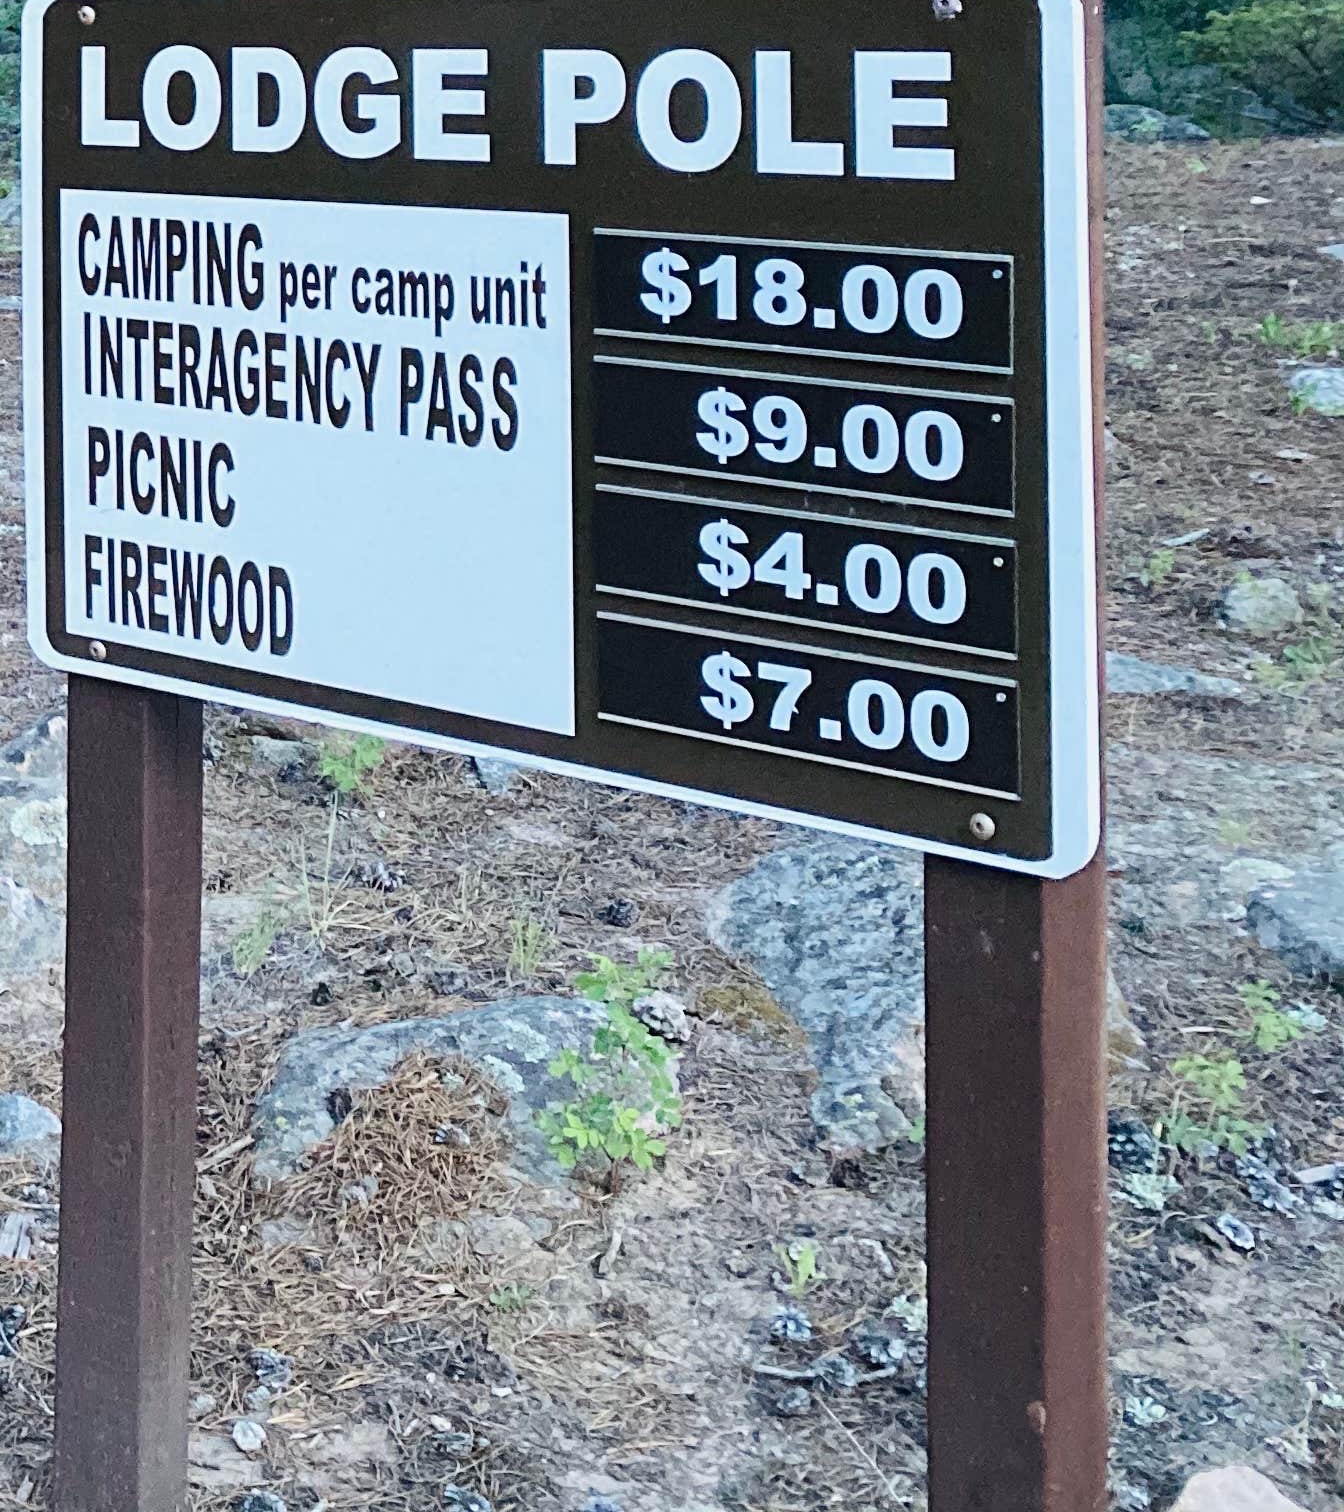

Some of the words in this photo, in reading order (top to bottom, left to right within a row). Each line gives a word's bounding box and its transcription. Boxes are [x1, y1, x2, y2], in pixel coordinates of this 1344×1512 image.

[80, 44, 492, 163] LODGE
[542, 48, 956, 180] POLE
[78, 212, 264, 311] CAMPING
[279, 260, 338, 323] per
[351, 266, 455, 337] camp
[470, 260, 548, 330] unit
[639, 247, 963, 340] $18.00
[83, 311, 382, 432] INTERAGENCY
[400, 347, 519, 452] PASS
[695, 386, 964, 482] $9.00
[88, 426, 236, 528] PICNIC
[84, 534, 294, 656] FIREWOOD
[697, 518, 967, 625] $4.00
[700, 650, 970, 763] $7.00
